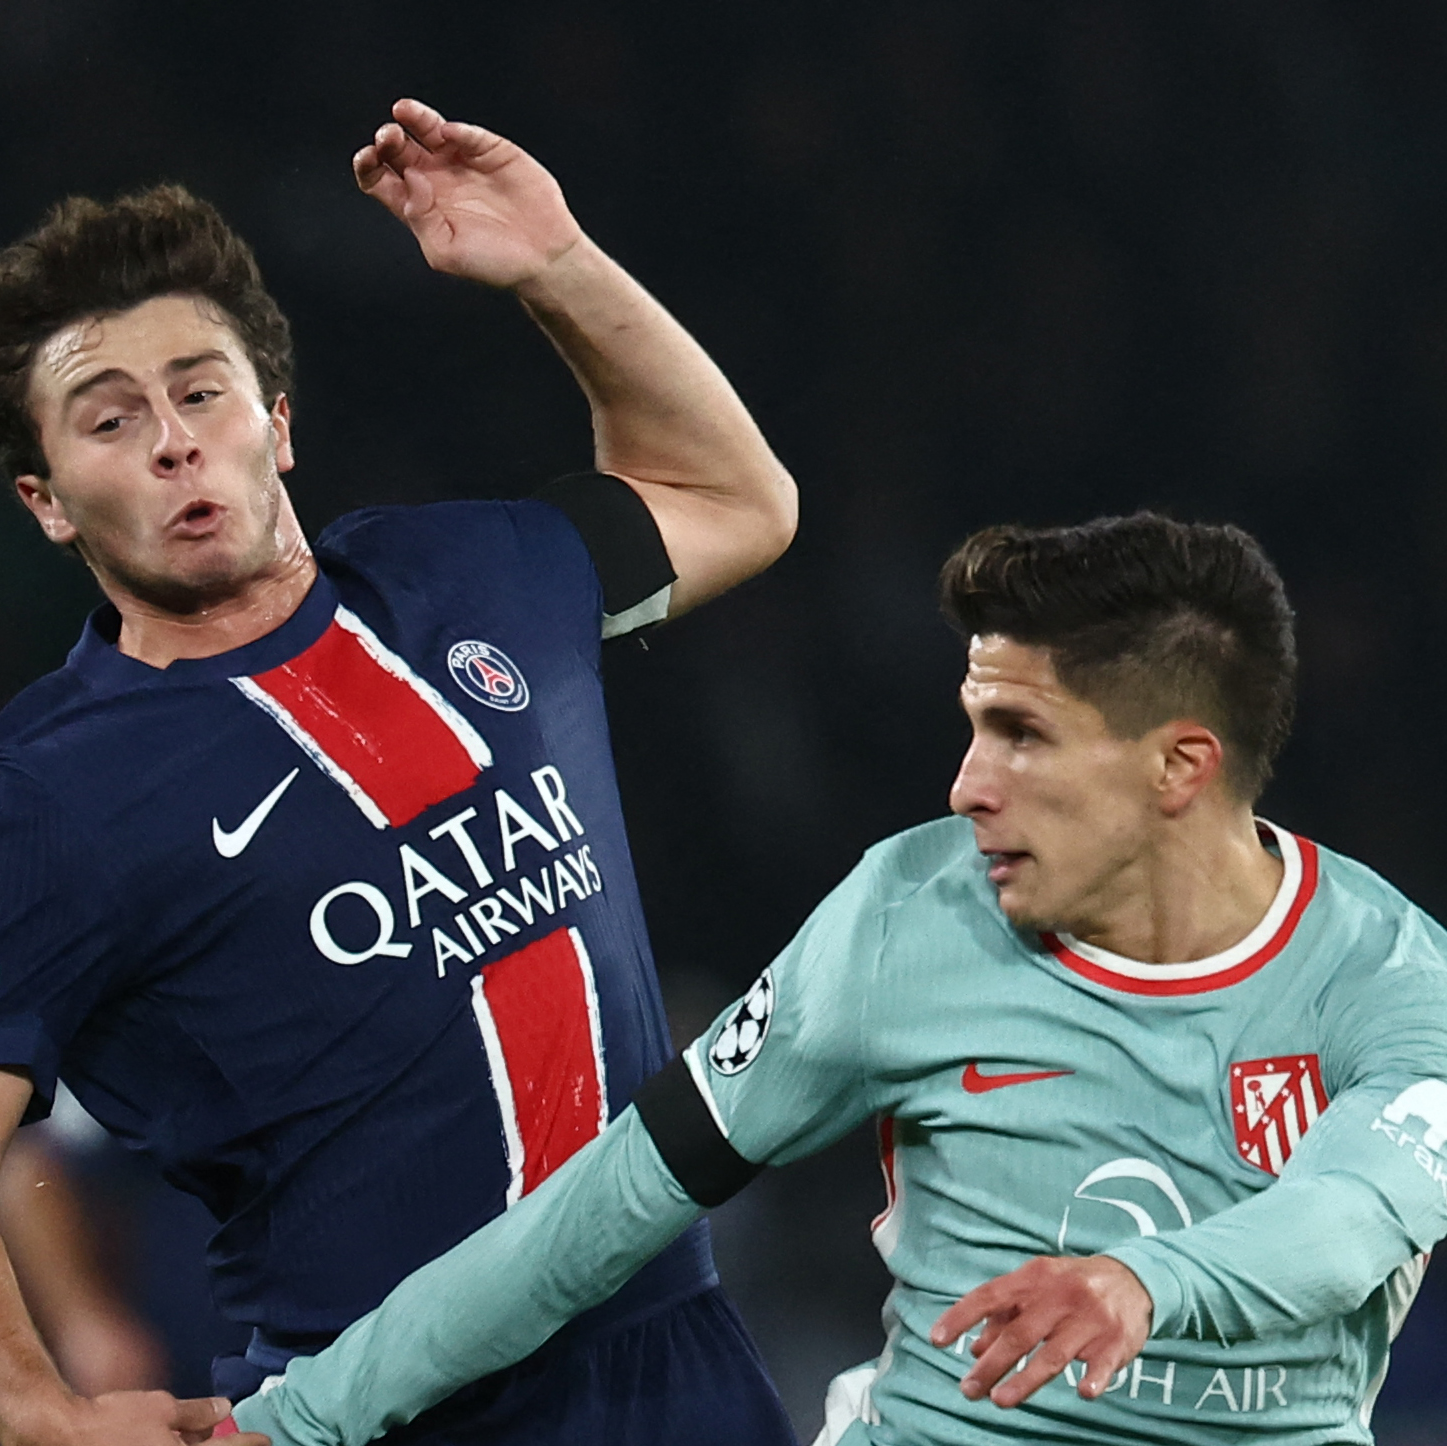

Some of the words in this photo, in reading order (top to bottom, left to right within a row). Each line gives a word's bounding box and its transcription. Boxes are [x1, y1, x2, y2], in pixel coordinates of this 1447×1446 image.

[452, 644, 491, 669] PARIS
[310, 765, 584, 965] QATAR
[432, 845, 601, 978] AIRWAYS
[1195, 1365, 1288, 1412] AIR
